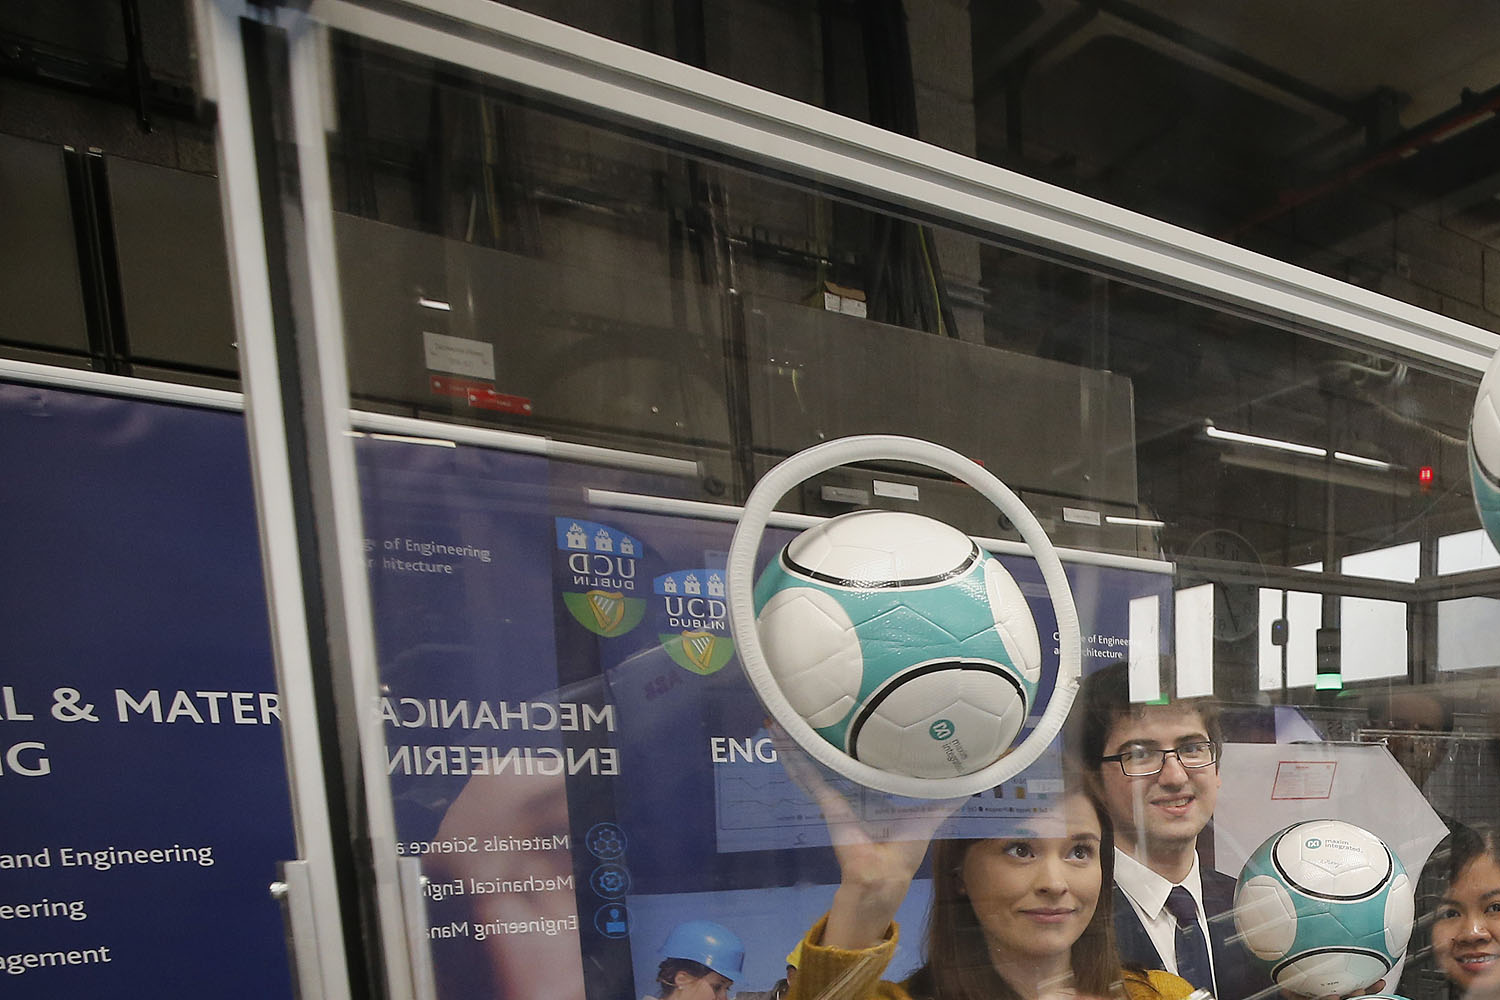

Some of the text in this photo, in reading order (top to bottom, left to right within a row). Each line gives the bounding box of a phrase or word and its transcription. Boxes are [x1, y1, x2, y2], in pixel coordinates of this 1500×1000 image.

[405, 538, 492, 563] Engineering
[664, 596, 727, 619] UCD
[669, 617, 725, 630] DUBLIN
[1087, 634, 1097, 643] of
[0, 686, 281, 725] L & MATER
[711, 737, 778, 764] ENG
[0, 844, 215, 871] and Engineering
